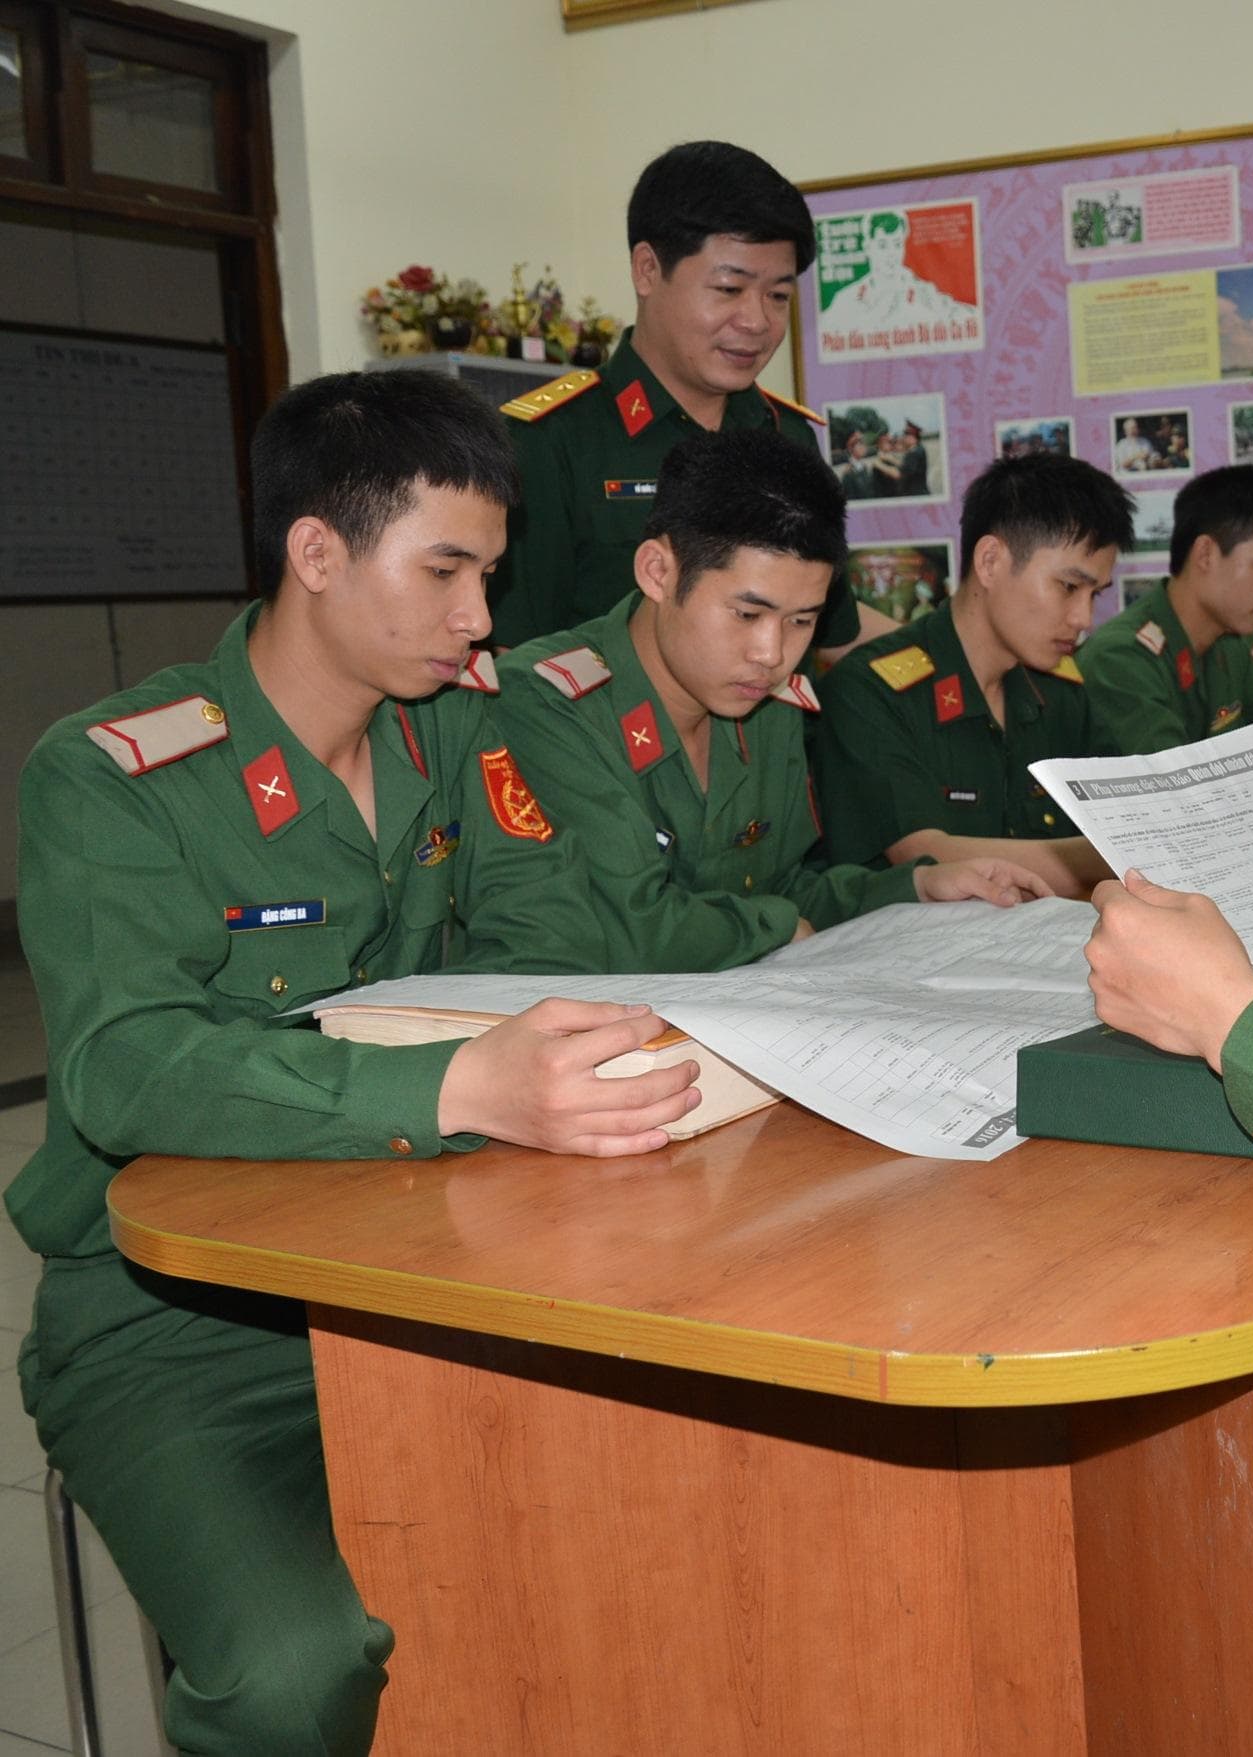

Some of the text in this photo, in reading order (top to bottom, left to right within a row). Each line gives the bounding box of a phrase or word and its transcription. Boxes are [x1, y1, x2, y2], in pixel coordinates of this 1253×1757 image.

[1072, 784, 1081, 796] 3
[1090, 783, 1114, 797] Phụ
[1109, 781, 1142, 794] trương
[1169, 774, 1192, 786] Báo
[1187, 763, 1214, 782] Quân
[975, 1123, 1004, 1144] 2016
